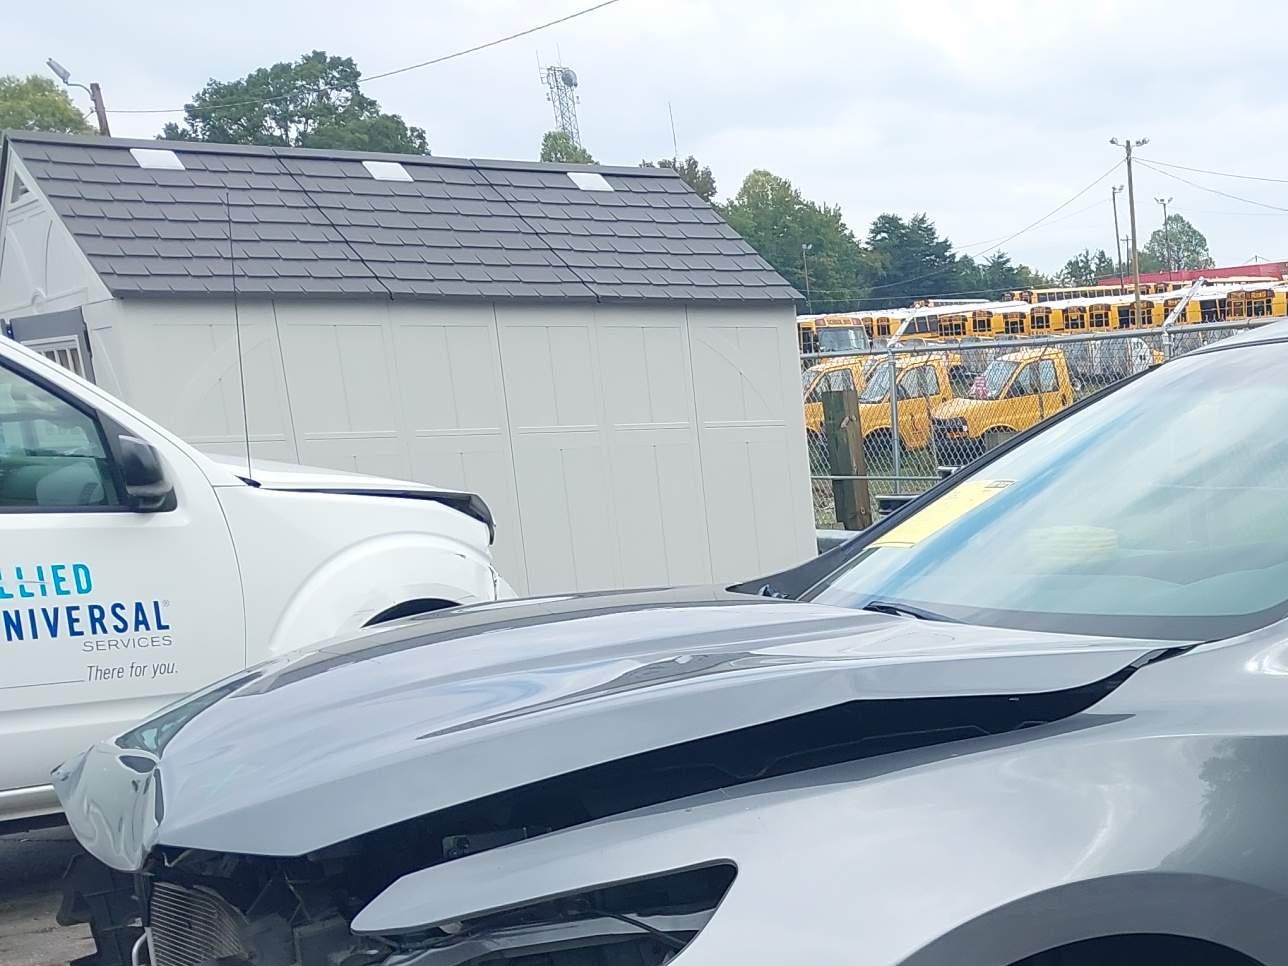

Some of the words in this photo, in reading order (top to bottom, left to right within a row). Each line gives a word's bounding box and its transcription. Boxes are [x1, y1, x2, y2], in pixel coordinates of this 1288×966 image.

[82, 636, 173, 652] SERVICES
[87, 664, 125, 681] There
[130, 661, 148, 677] for
[152, 662, 178, 679] you.
